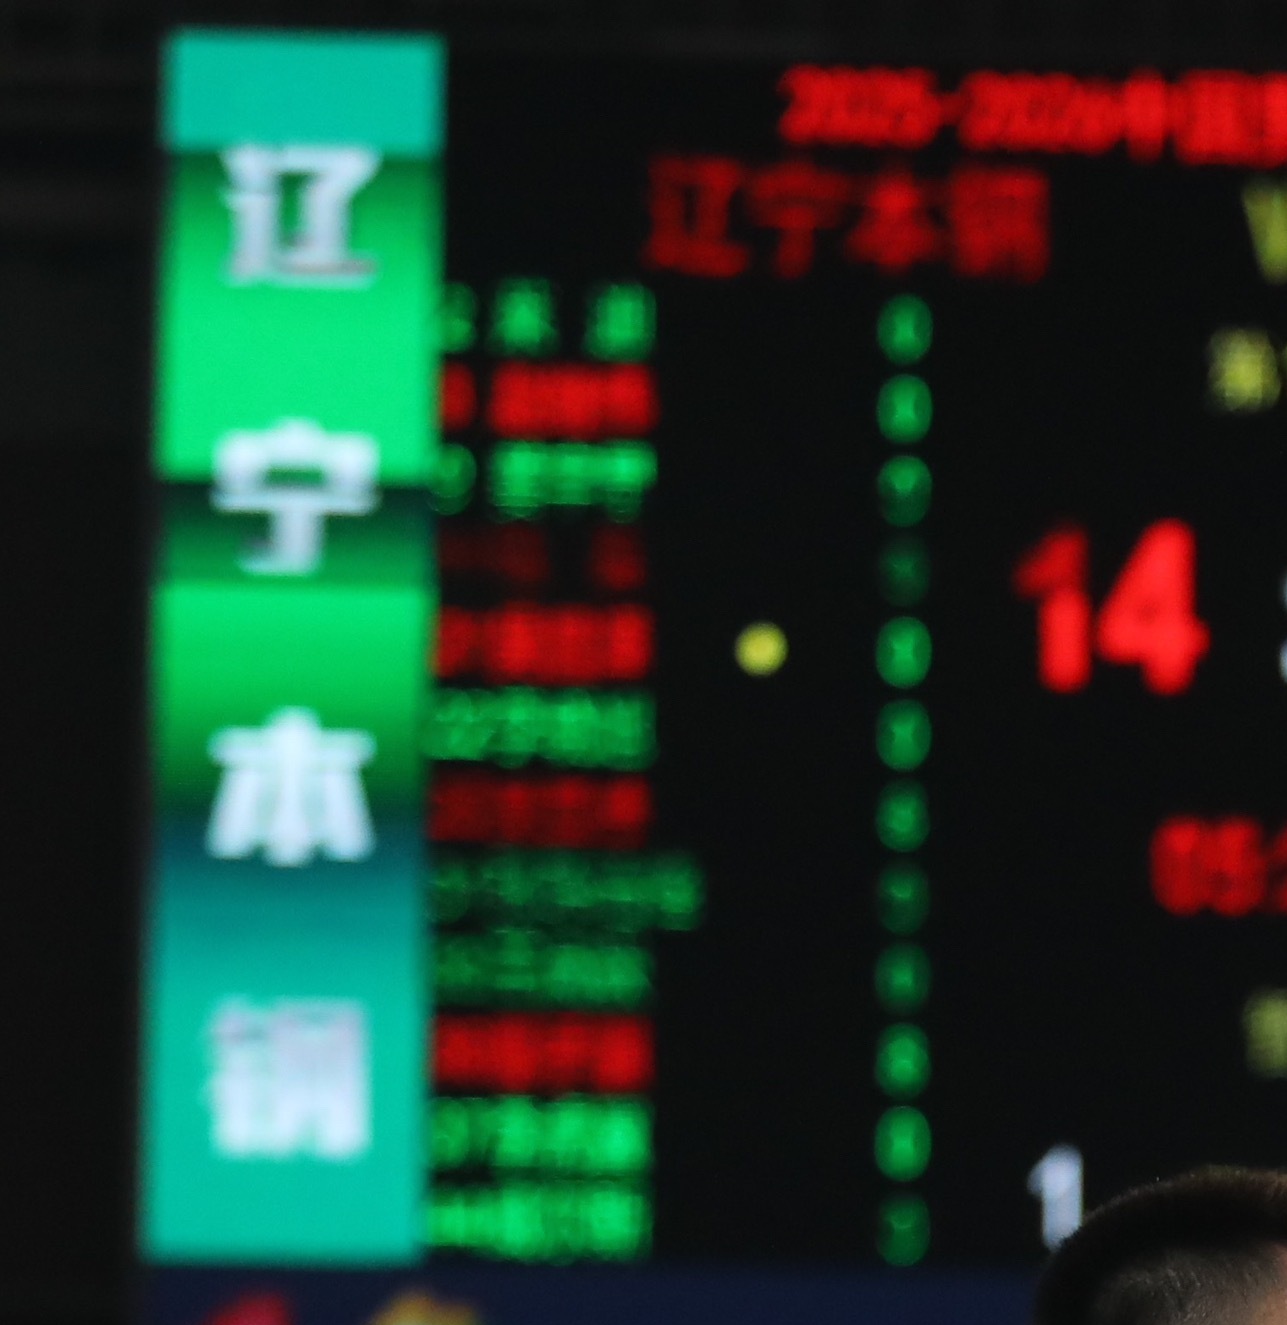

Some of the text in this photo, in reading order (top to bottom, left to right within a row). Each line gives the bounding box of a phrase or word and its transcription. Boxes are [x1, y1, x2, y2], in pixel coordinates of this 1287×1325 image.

[207, 142, 380, 1160] 辽宁本钢
[1014, 518, 1210, 694] 14
